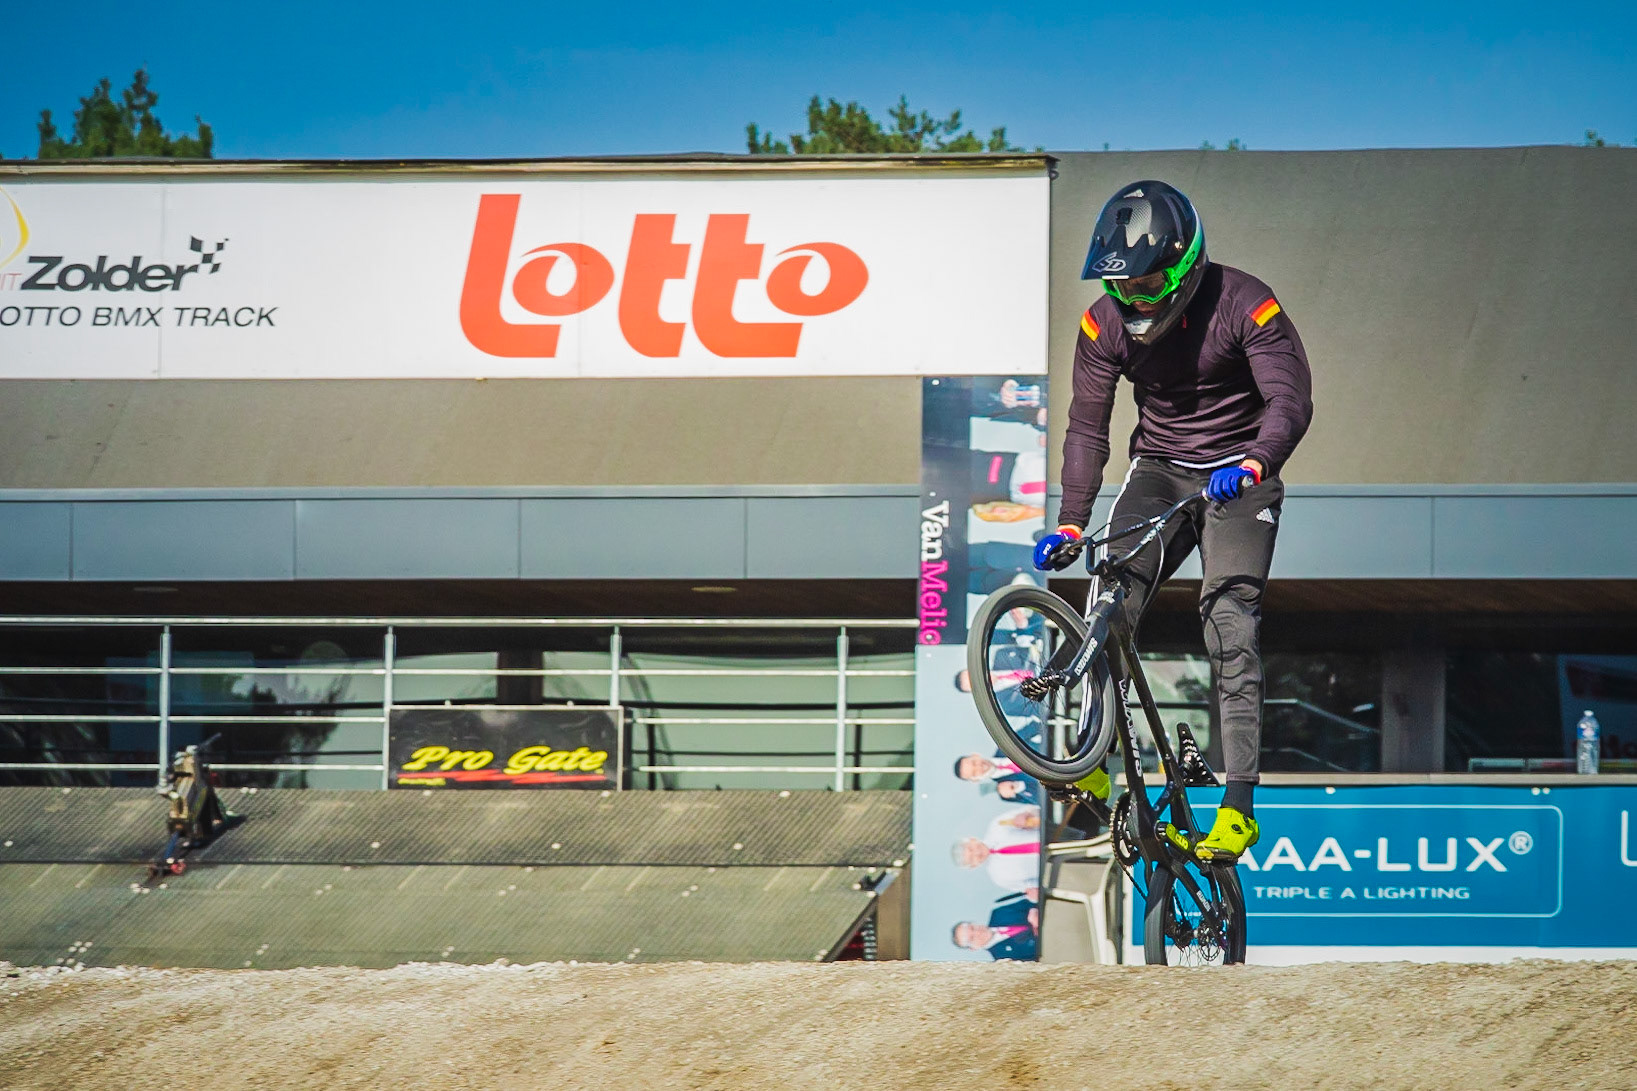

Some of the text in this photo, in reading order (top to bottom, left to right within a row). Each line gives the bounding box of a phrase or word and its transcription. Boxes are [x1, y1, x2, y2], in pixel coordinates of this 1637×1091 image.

[21, 255, 198, 292] Zolder
[0, 306, 279, 327] OTTO BMX TRACK
[402, 746, 494, 771] Pro
[1254, 886, 1470, 899] TRIPLE A LIGHTING
